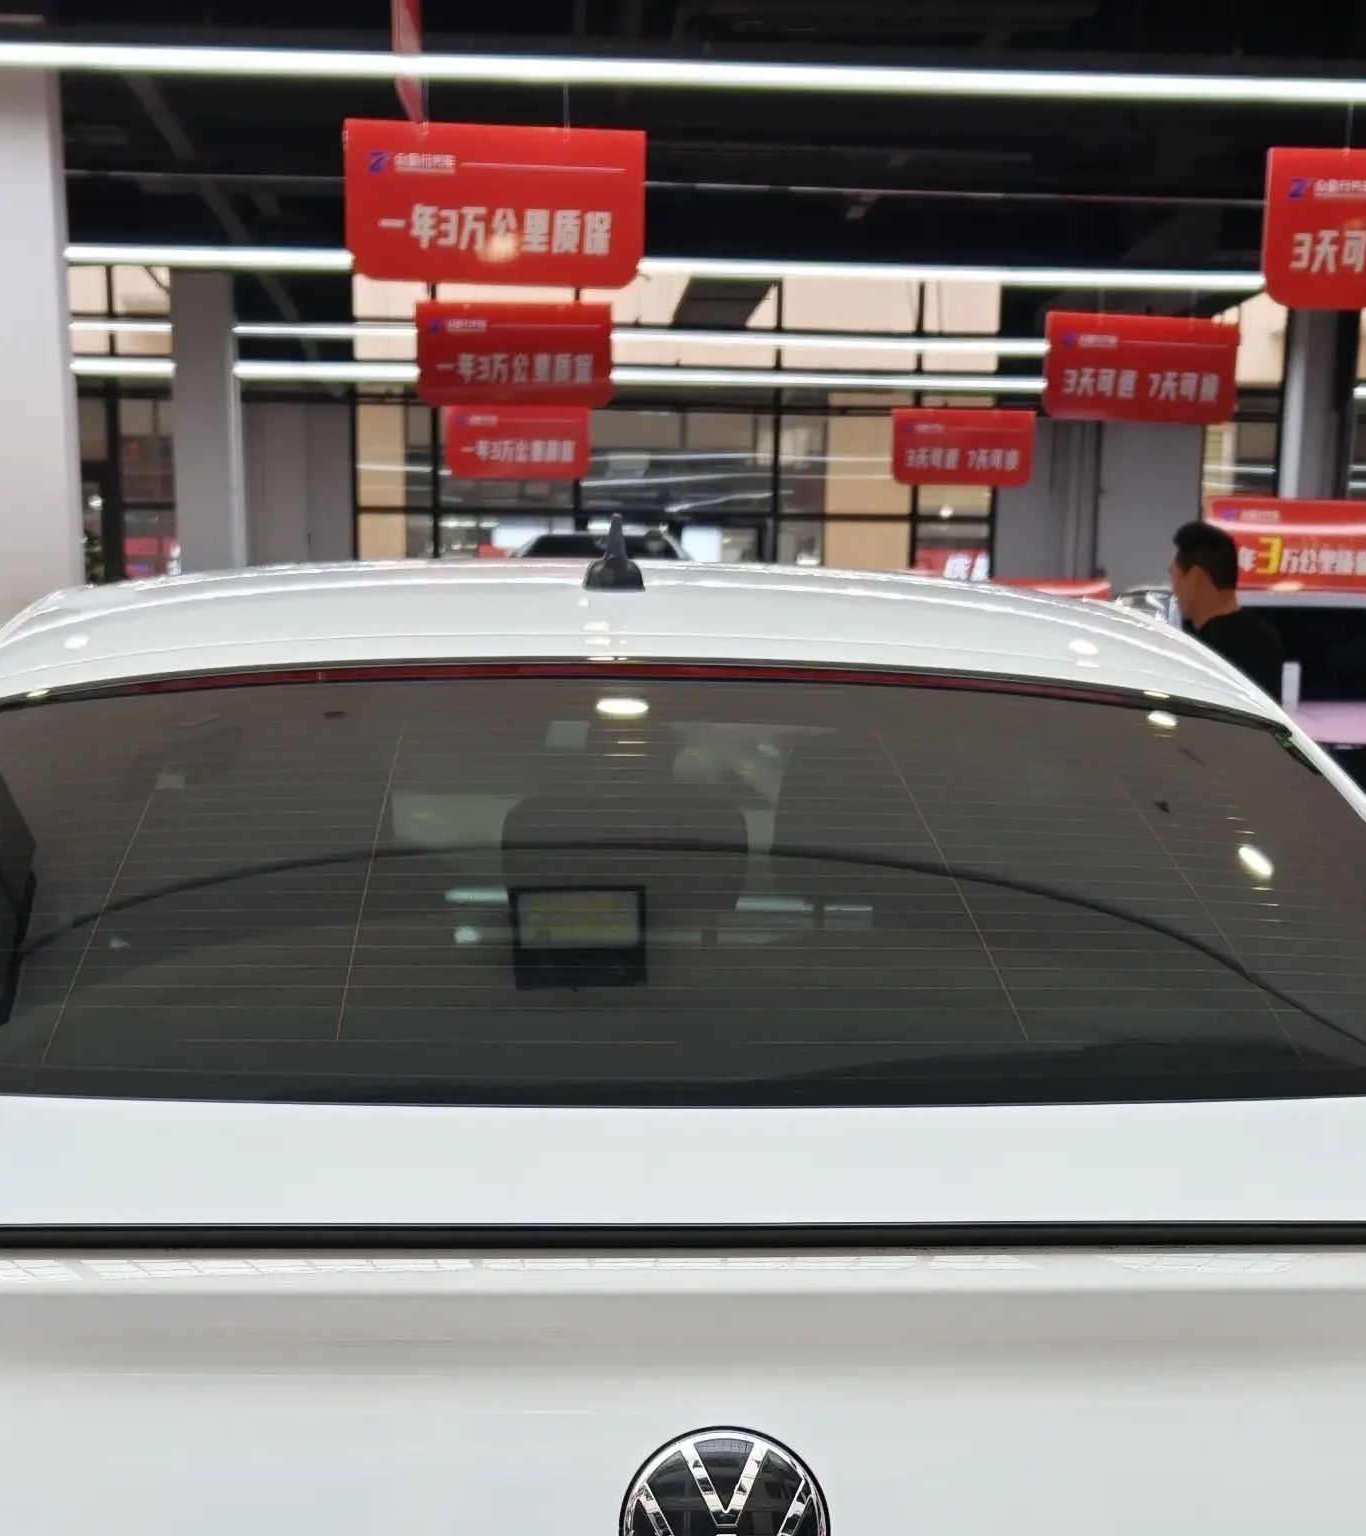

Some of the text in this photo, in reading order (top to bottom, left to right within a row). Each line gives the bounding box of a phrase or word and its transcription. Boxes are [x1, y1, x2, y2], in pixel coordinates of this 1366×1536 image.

[378, 204, 611, 256] 一年3万公里质保
